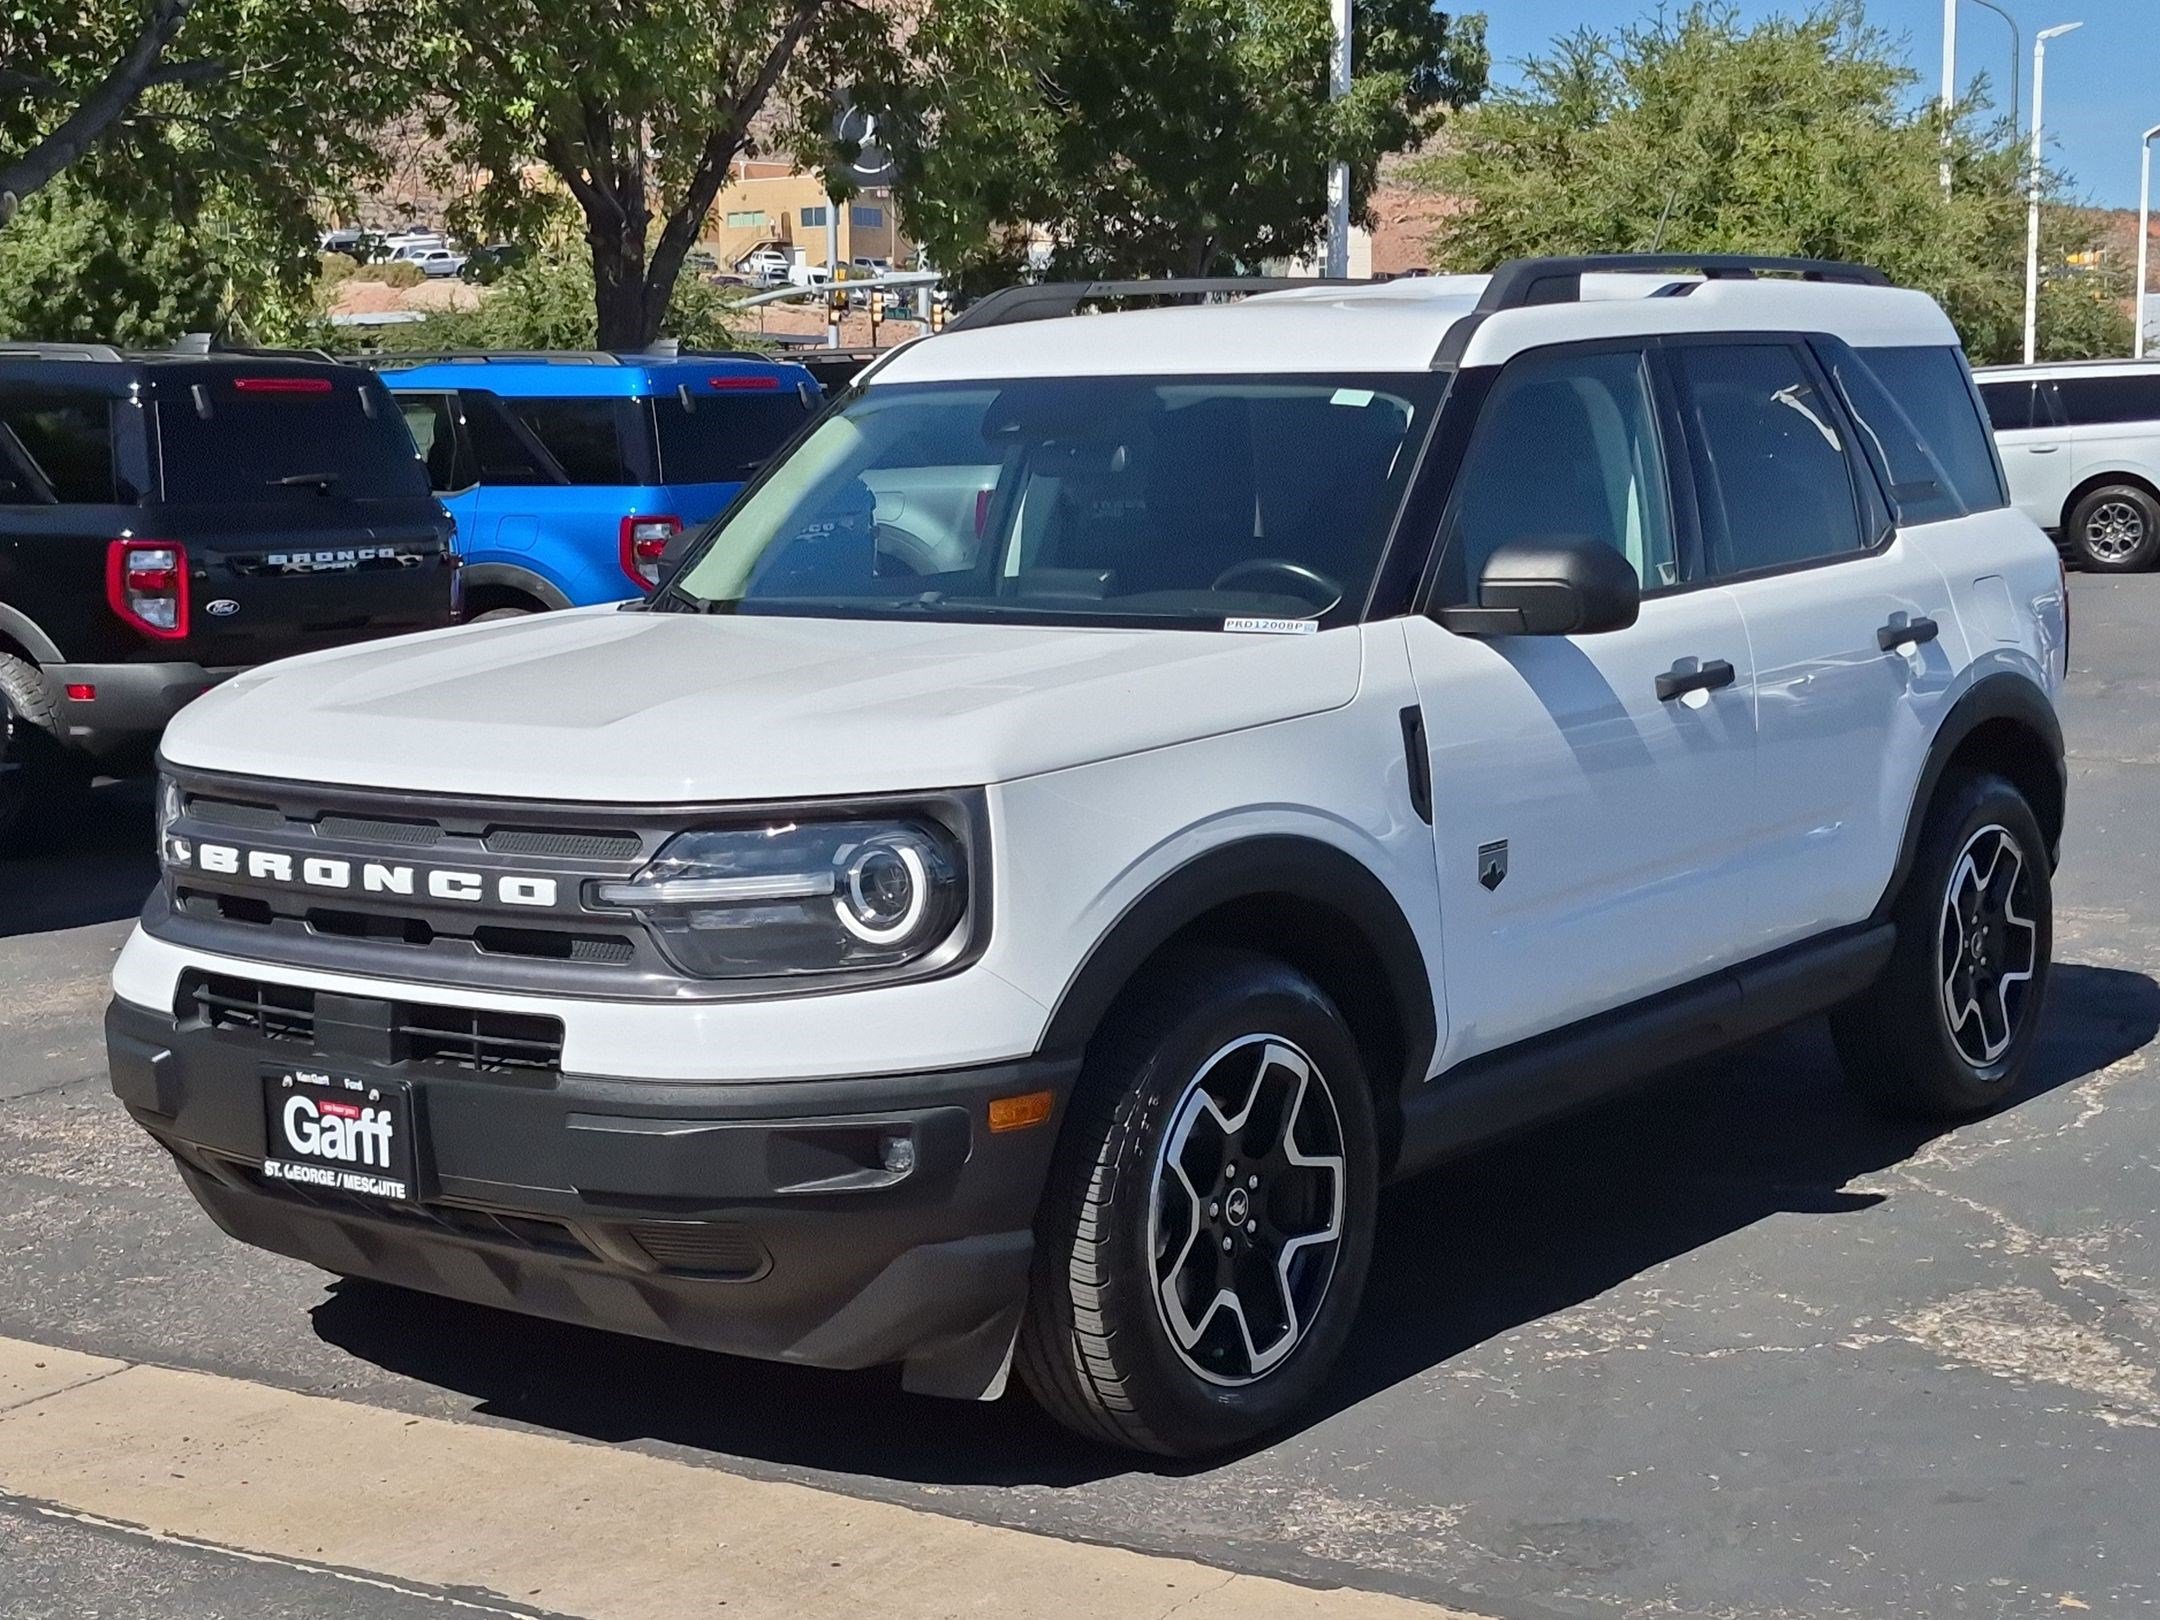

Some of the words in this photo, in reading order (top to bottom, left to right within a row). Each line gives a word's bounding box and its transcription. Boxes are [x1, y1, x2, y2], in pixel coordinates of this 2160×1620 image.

[268, 548, 394, 565] BRONCO
[200, 843, 557, 906] BRONCO
[284, 1095, 393, 1168] Garff
[264, 1160, 283, 1177] ST.
[284, 1164, 336, 1187] GEORGE
